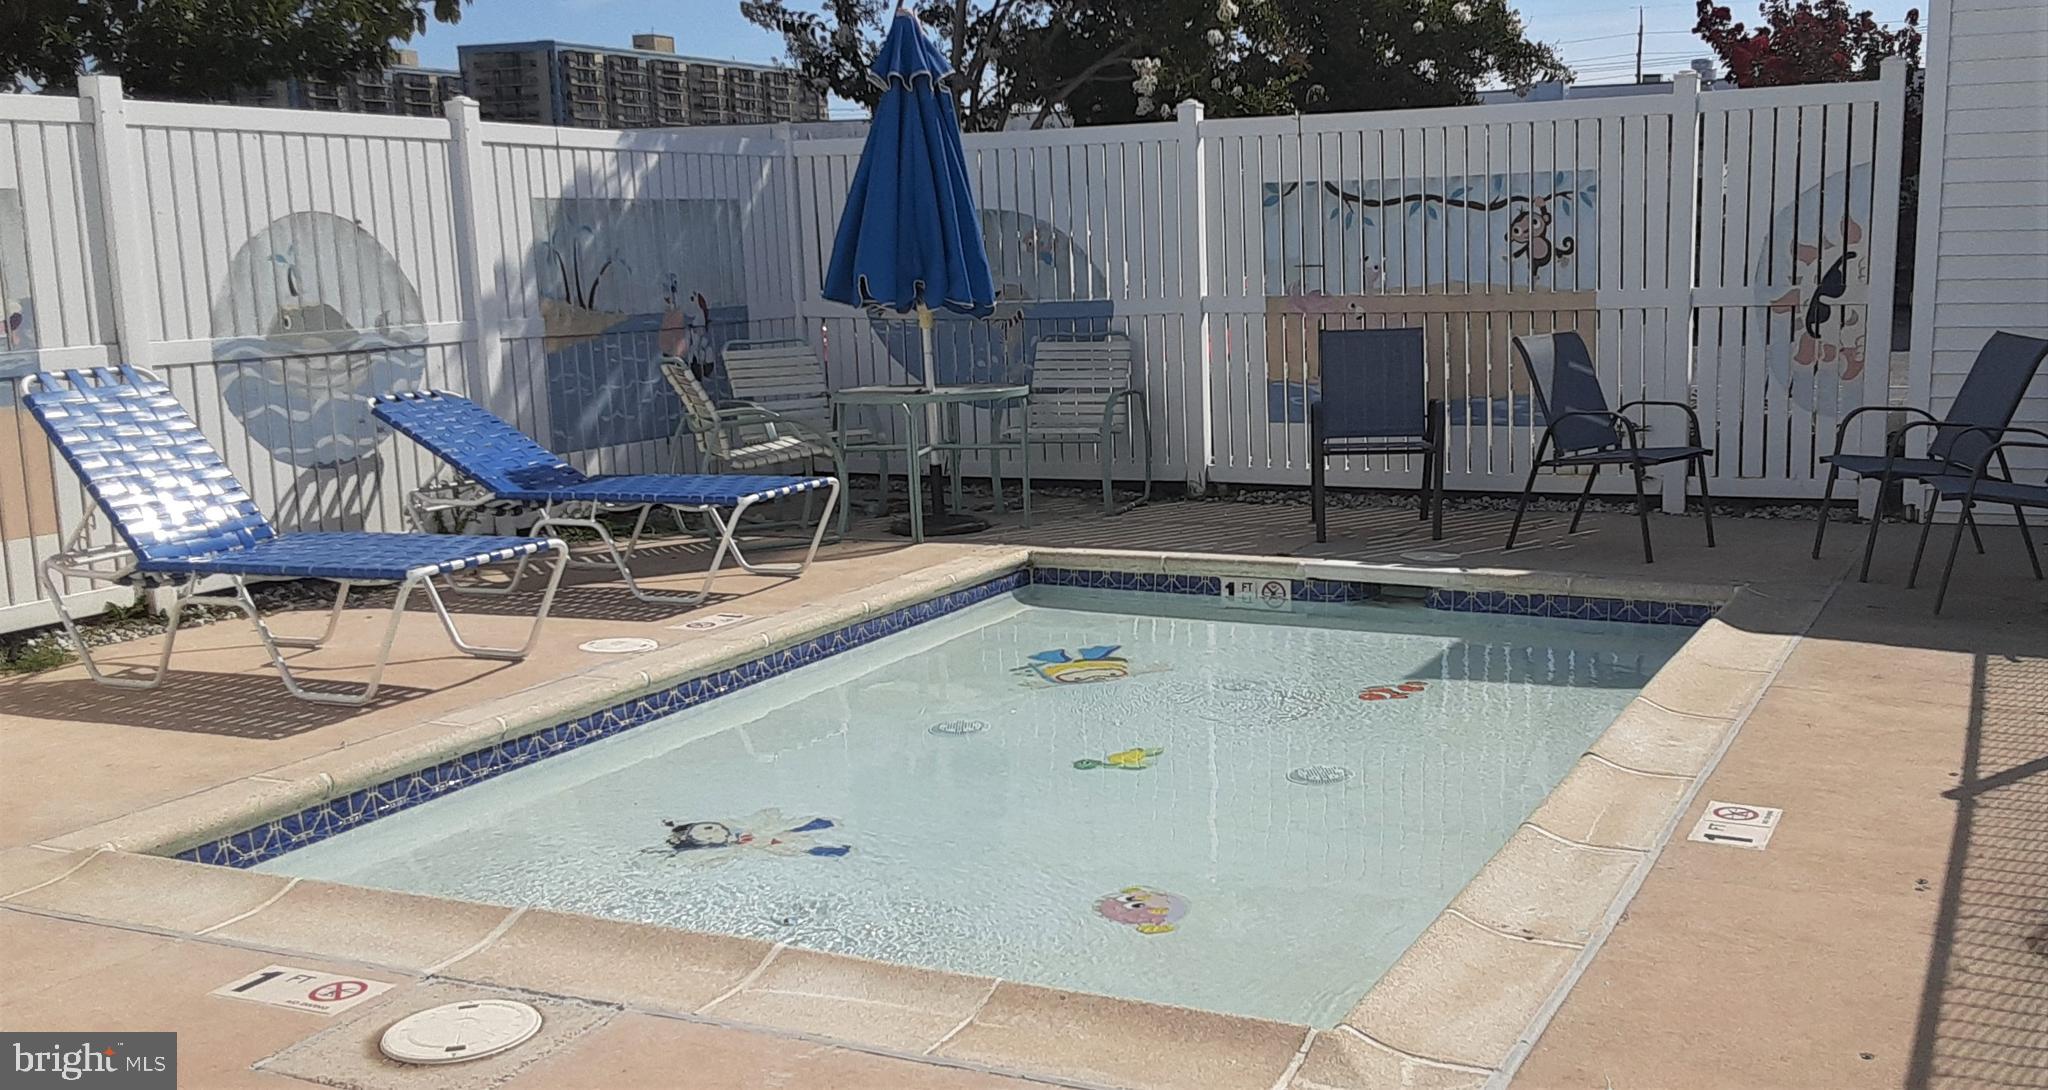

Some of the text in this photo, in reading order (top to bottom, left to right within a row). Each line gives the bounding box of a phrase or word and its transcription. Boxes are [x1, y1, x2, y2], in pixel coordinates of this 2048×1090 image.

[1225, 582, 1253, 596] 1 FT
[1703, 823, 1754, 843] 1 FT
[231, 971, 317, 992] 1 FT
